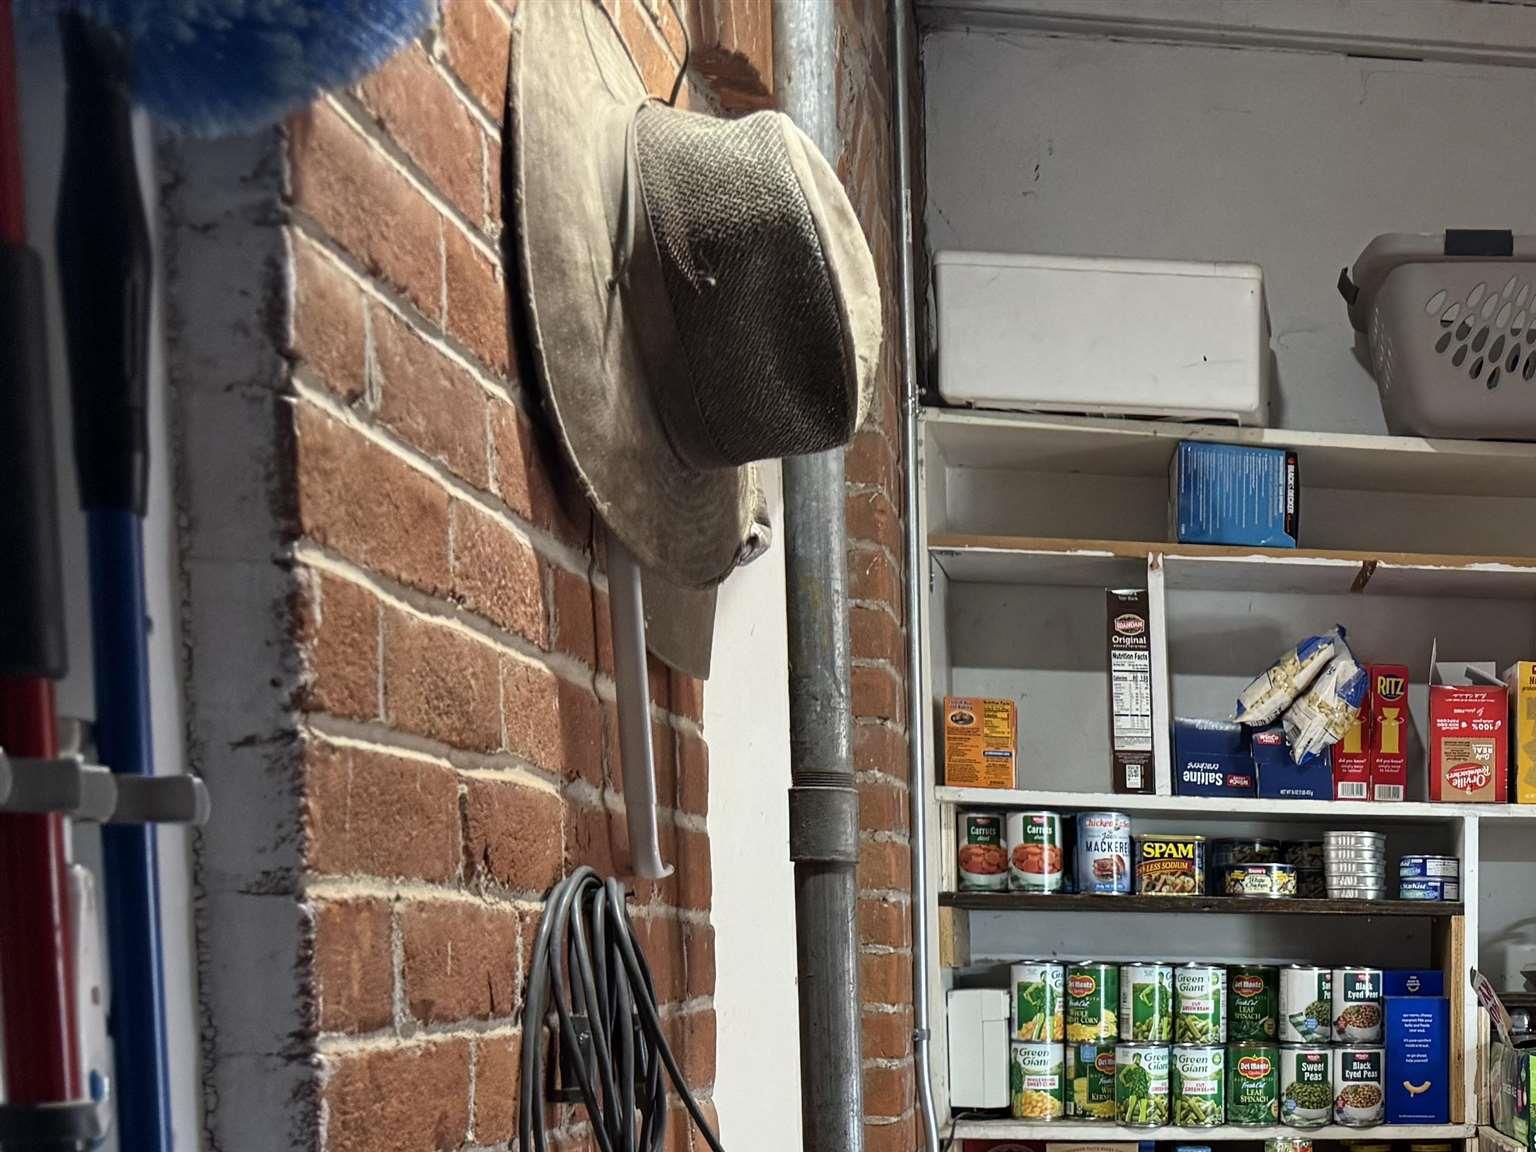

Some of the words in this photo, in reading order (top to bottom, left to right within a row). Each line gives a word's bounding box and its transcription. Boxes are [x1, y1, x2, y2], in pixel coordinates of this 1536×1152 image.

[1112, 636, 1147, 645] Original
[1112, 652, 1134, 661] Nutrition
[1134, 652, 1148, 661] Facts
[1377, 676, 1404, 696] RITZ
[1183, 770, 1223, 786] Saltine
[1452, 774, 1486, 788] Orville
[1085, 841, 1129, 853] MACKERE
[1143, 842, 1194, 859] SPAM
[1147, 862, 1161, 872] LESS
[1162, 860, 1188, 870] SODIUM
[1180, 983, 1205, 992] Giant
[1080, 1016, 1099, 1024] CORN
[1179, 1054, 1208, 1064] Green
[1181, 1064, 1208, 1073] Giant
[1301, 1062, 1324, 1072] Sweet
[1352, 1061, 1371, 1070] Black
[1304, 1072, 1322, 1081] Peas
[1362, 1069, 1378, 1078] Peas
[1246, 1088, 1264, 1096] LEAF
[1240, 1095, 1269, 1103] SPINACH
